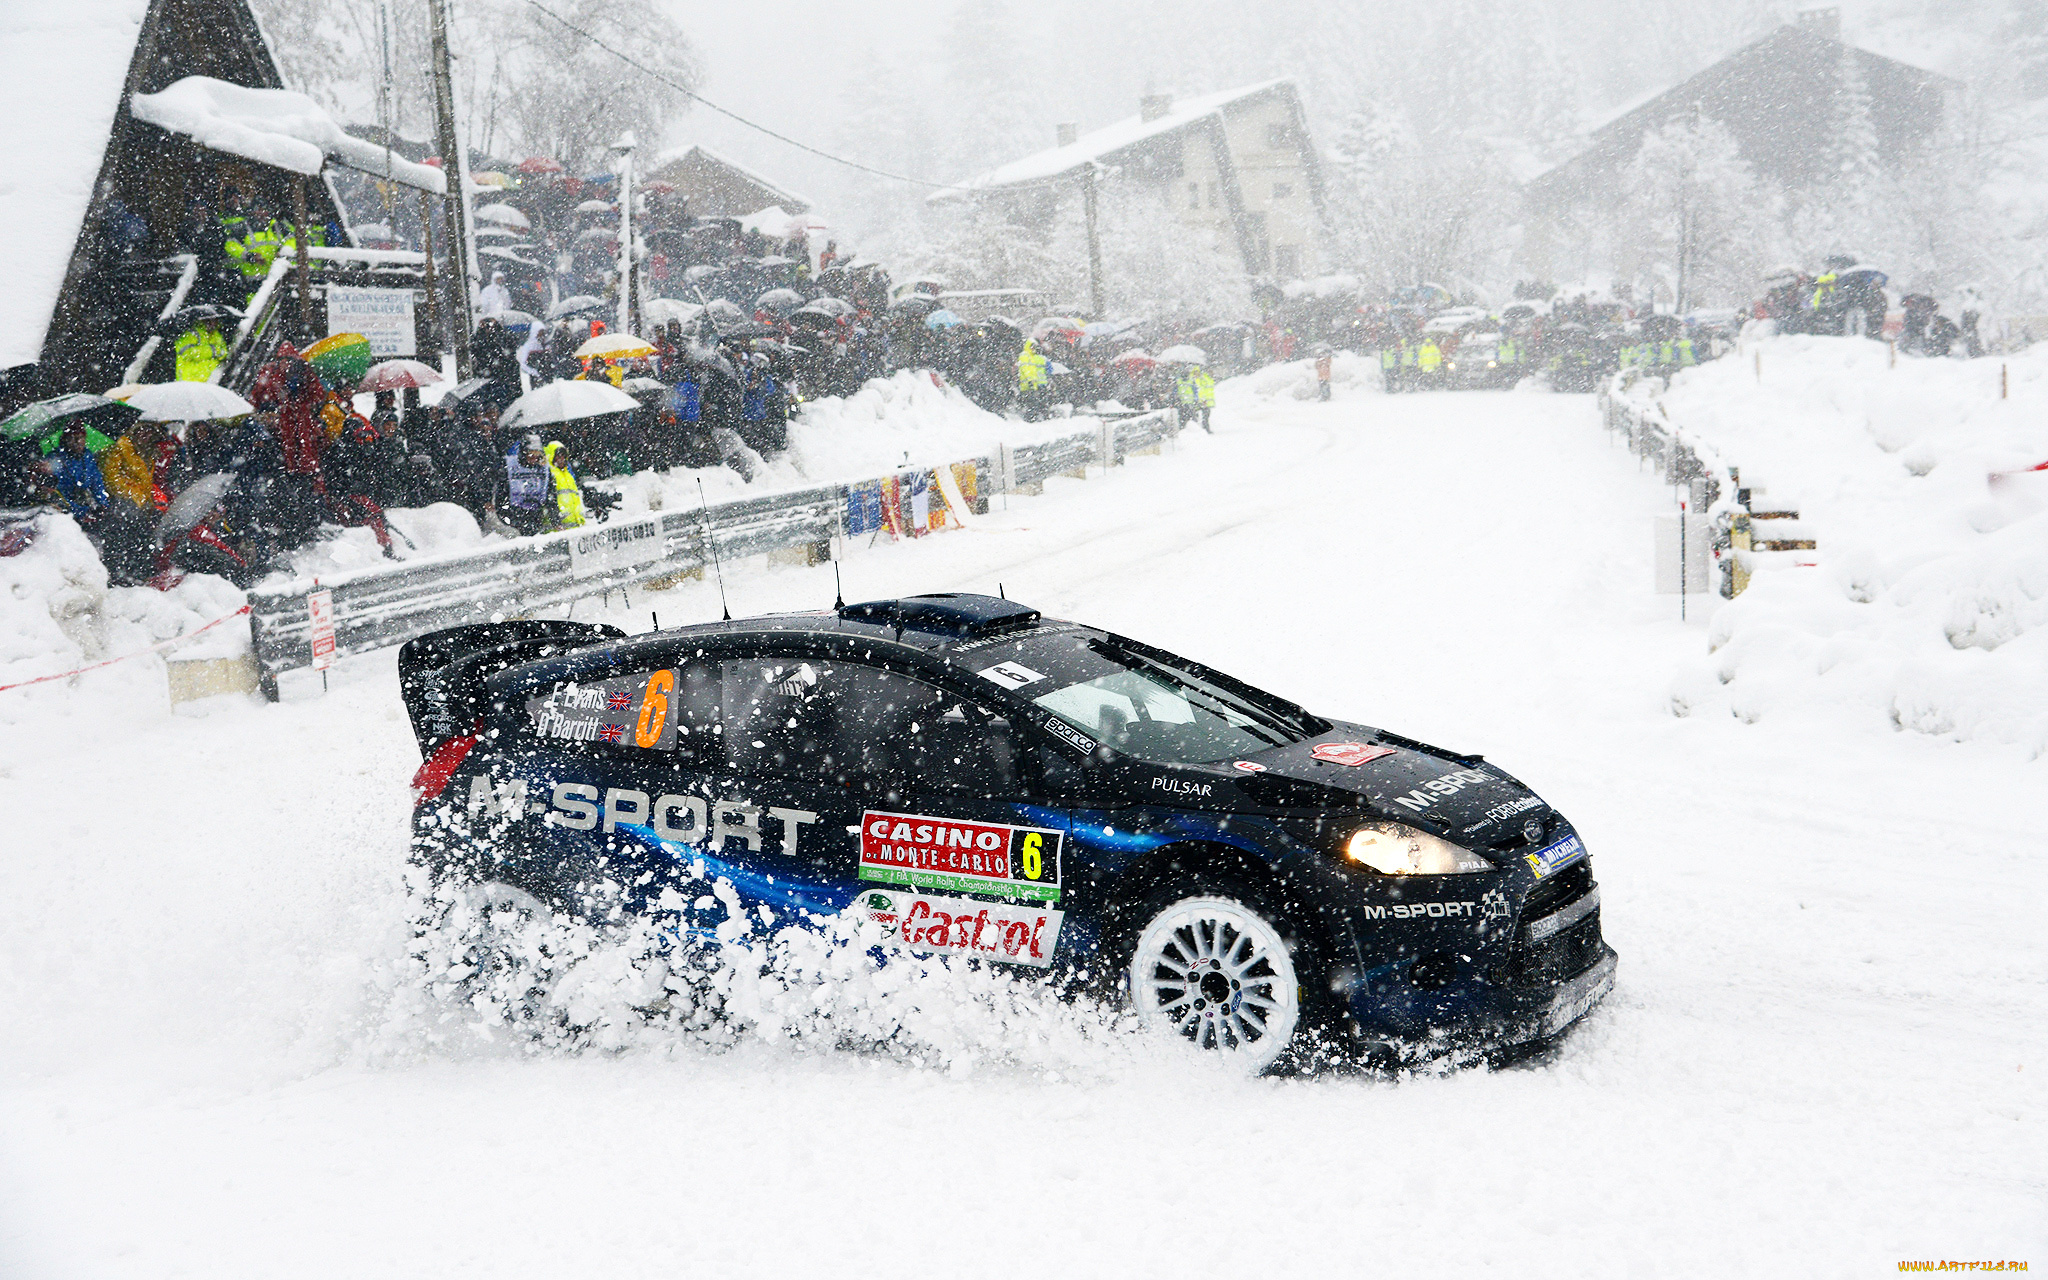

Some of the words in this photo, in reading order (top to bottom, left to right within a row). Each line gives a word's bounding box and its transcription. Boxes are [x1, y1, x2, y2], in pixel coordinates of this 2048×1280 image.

[992, 666, 1030, 682] 6
[635, 669, 675, 748] 6
[536, 712, 549, 737] D
[551, 713, 600, 741] Barritt
[1048, 719, 1094, 752] sparco
[1151, 777, 1212, 797] PULSAR
[1394, 768, 1499, 811] M-SPORT
[468, 775, 817, 856] M-SPORT
[1485, 801, 1517, 823] FORD
[869, 820, 1002, 851] CASINO
[1544, 836, 1582, 862] MICHELIN
[1022, 832, 1043, 880] 6
[1458, 859, 1489, 870] PIAA
[896, 872, 909, 881] FIA
[911, 873, 934, 885] World
[936, 876, 956, 889] Rally
[958, 878, 1013, 893] Championship
[1364, 901, 1476, 920] M-SPORT
[901, 900, 1047, 959] Castrol
